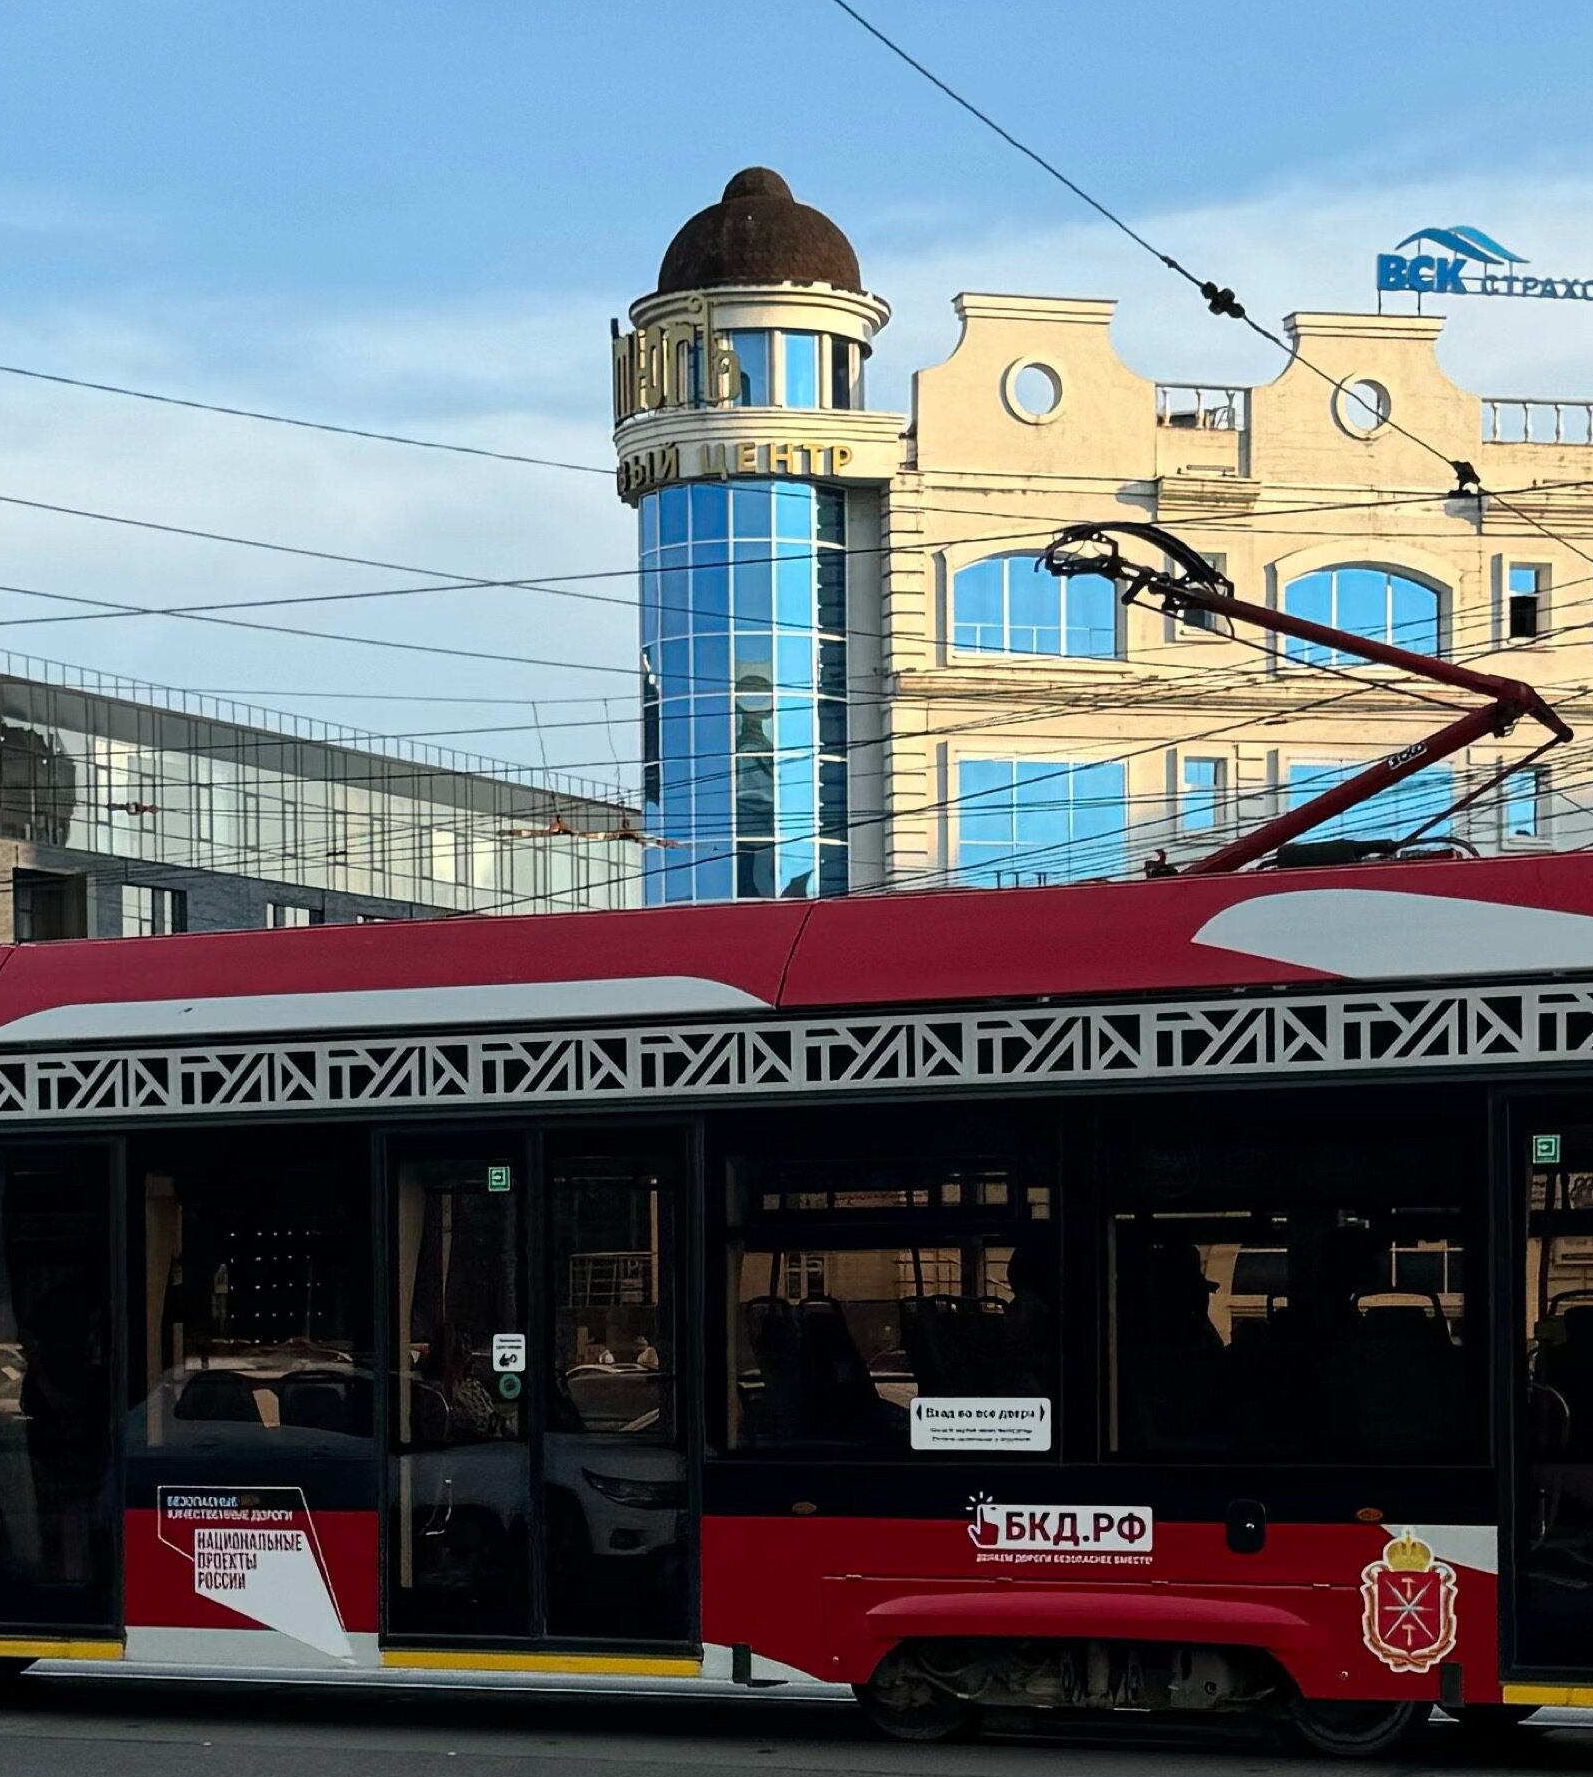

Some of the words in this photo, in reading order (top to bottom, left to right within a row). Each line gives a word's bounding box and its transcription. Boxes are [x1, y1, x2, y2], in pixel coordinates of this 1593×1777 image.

[1376, 253, 1467, 295] ВСК
[700, 441, 853, 482] ЦЕНТР
[197, 1531, 303, 1551] НАЦИОНАЛЬНЫЕ
[1005, 1512, 1147, 1547] БКД.РФ
[197, 1552, 257, 1570] ПРОЕКТЫ
[198, 1572, 246, 1590] РОССИИ
